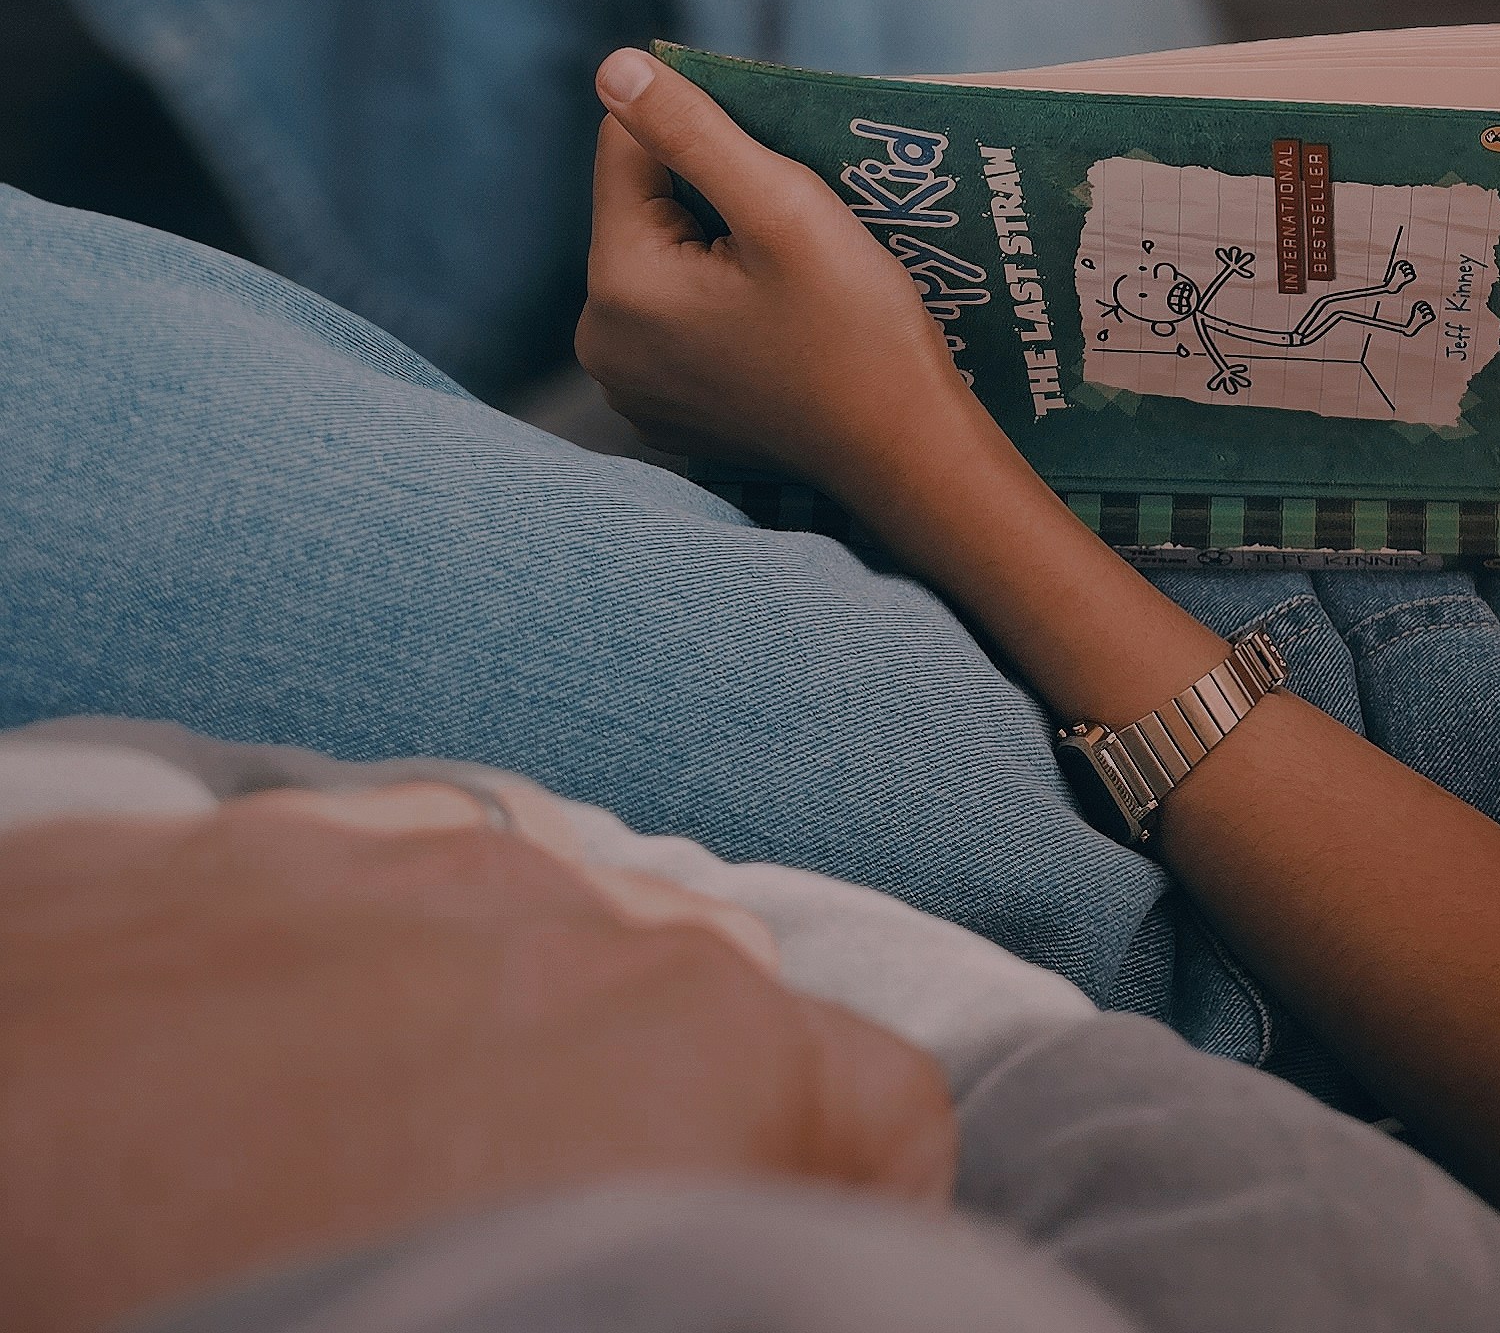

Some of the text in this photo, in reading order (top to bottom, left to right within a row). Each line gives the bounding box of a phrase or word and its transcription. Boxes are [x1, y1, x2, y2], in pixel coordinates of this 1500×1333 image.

[841, 118, 960, 228] Kid
[1279, 146, 1328, 292] INTERNATIONAL BESTSELLER
[980, 145, 1068, 417] THE LAST STRAW
[1445, 253, 1489, 362] Jeff Kinney
[1247, 552, 1429, 566] JEFF KINNEY
